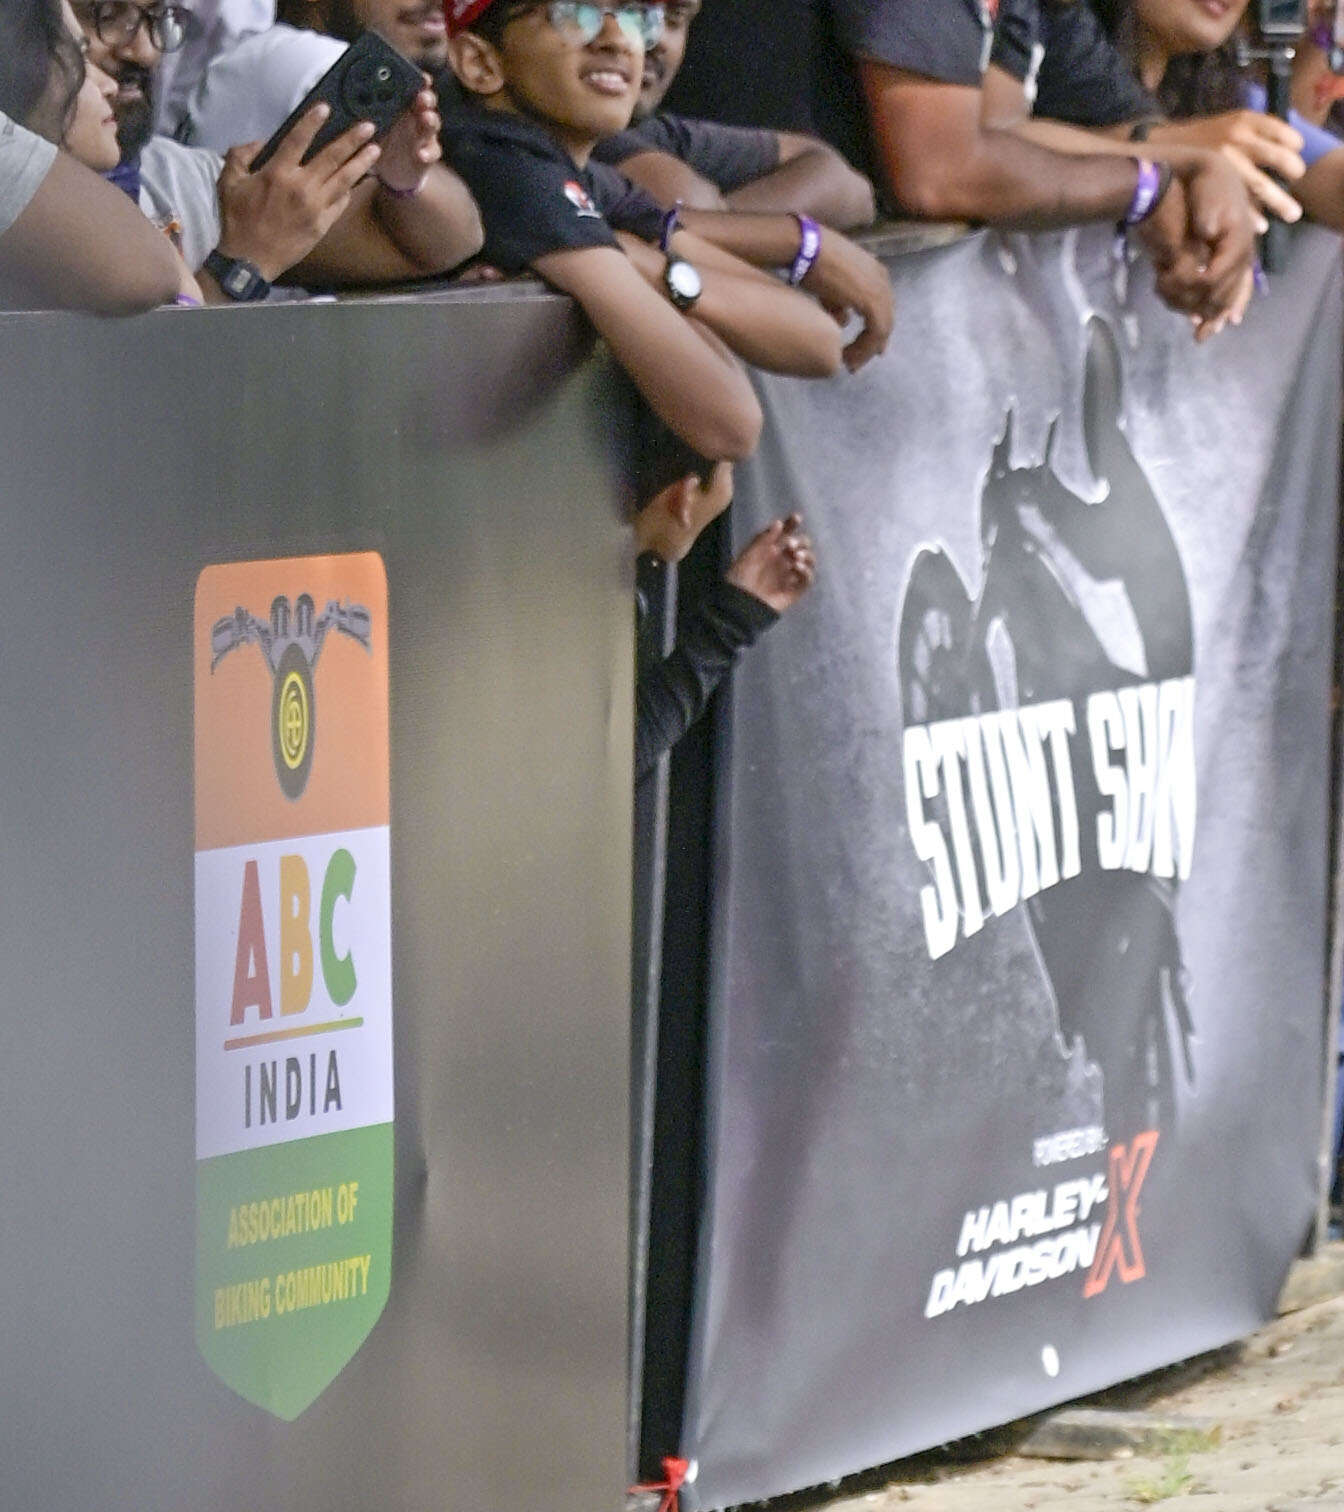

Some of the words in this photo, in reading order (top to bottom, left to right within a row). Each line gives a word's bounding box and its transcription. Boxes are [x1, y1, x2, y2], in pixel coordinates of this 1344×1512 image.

[903, 697, 1081, 961] STUNT
[230, 848, 358, 1026] ABC
[245, 1050, 343, 1129] INDIA
[228, 1187, 333, 1249] ASSOCIATION
[337, 1181, 359, 1224] OF
[1081, 1130, 1161, 1301] X
[214, 1277, 271, 1330] BIKING
[275, 1254, 371, 1315] COMMUNITY
[924, 1224, 1102, 1318] DAVIDSON
